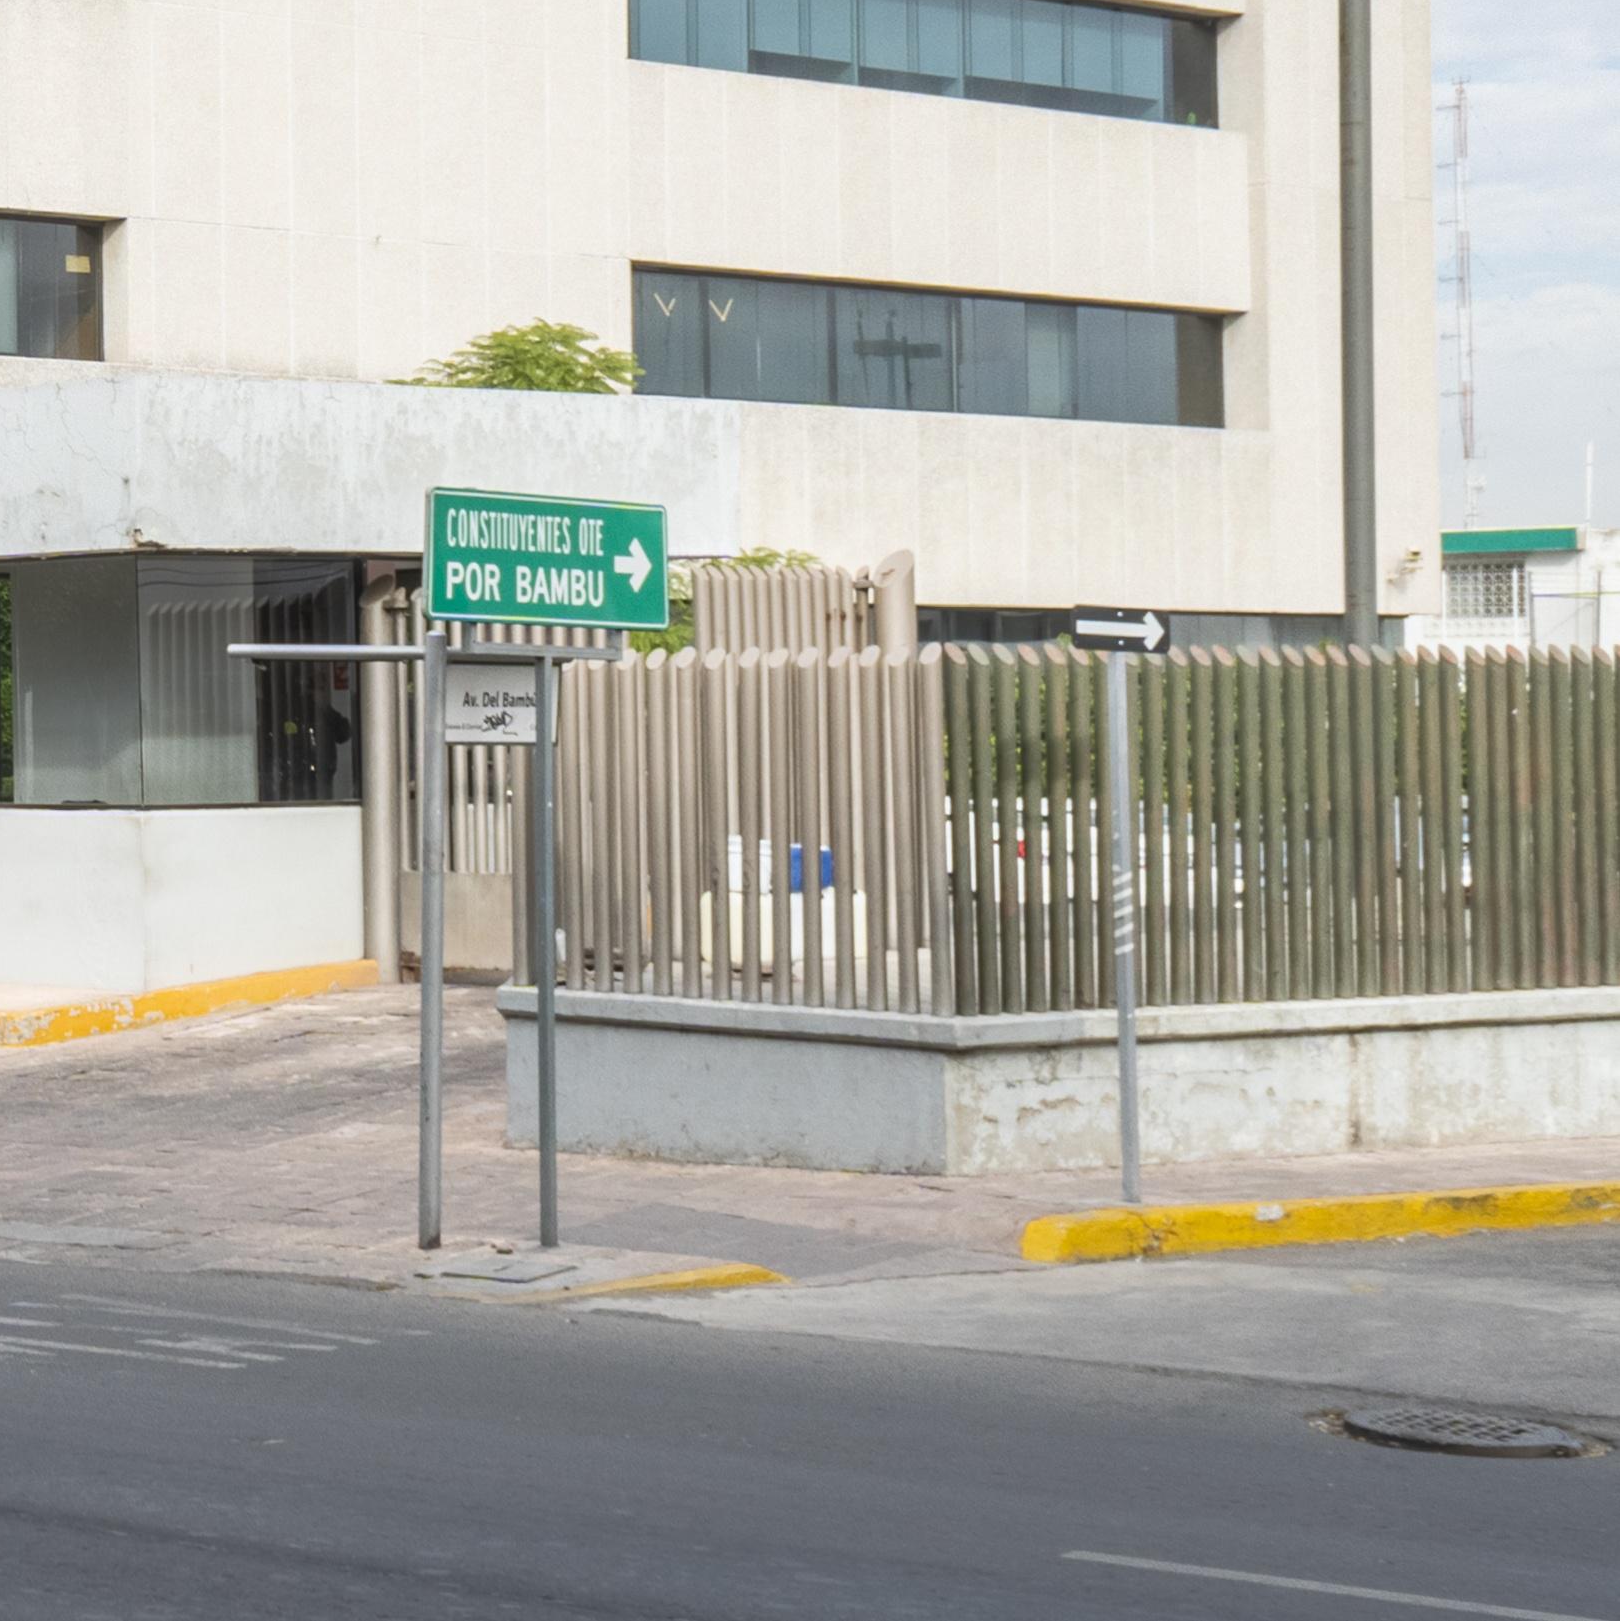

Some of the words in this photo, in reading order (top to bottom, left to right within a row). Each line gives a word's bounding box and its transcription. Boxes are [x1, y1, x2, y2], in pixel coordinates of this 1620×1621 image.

[446, 507, 572, 555] CONSTITUYENTES
[578, 516, 605, 557] OTE
[445, 560, 502, 602] POR
[515, 565, 605, 608] BAMBU
[462, 691, 480, 708] Av.
[482, 690, 499, 708] Del
